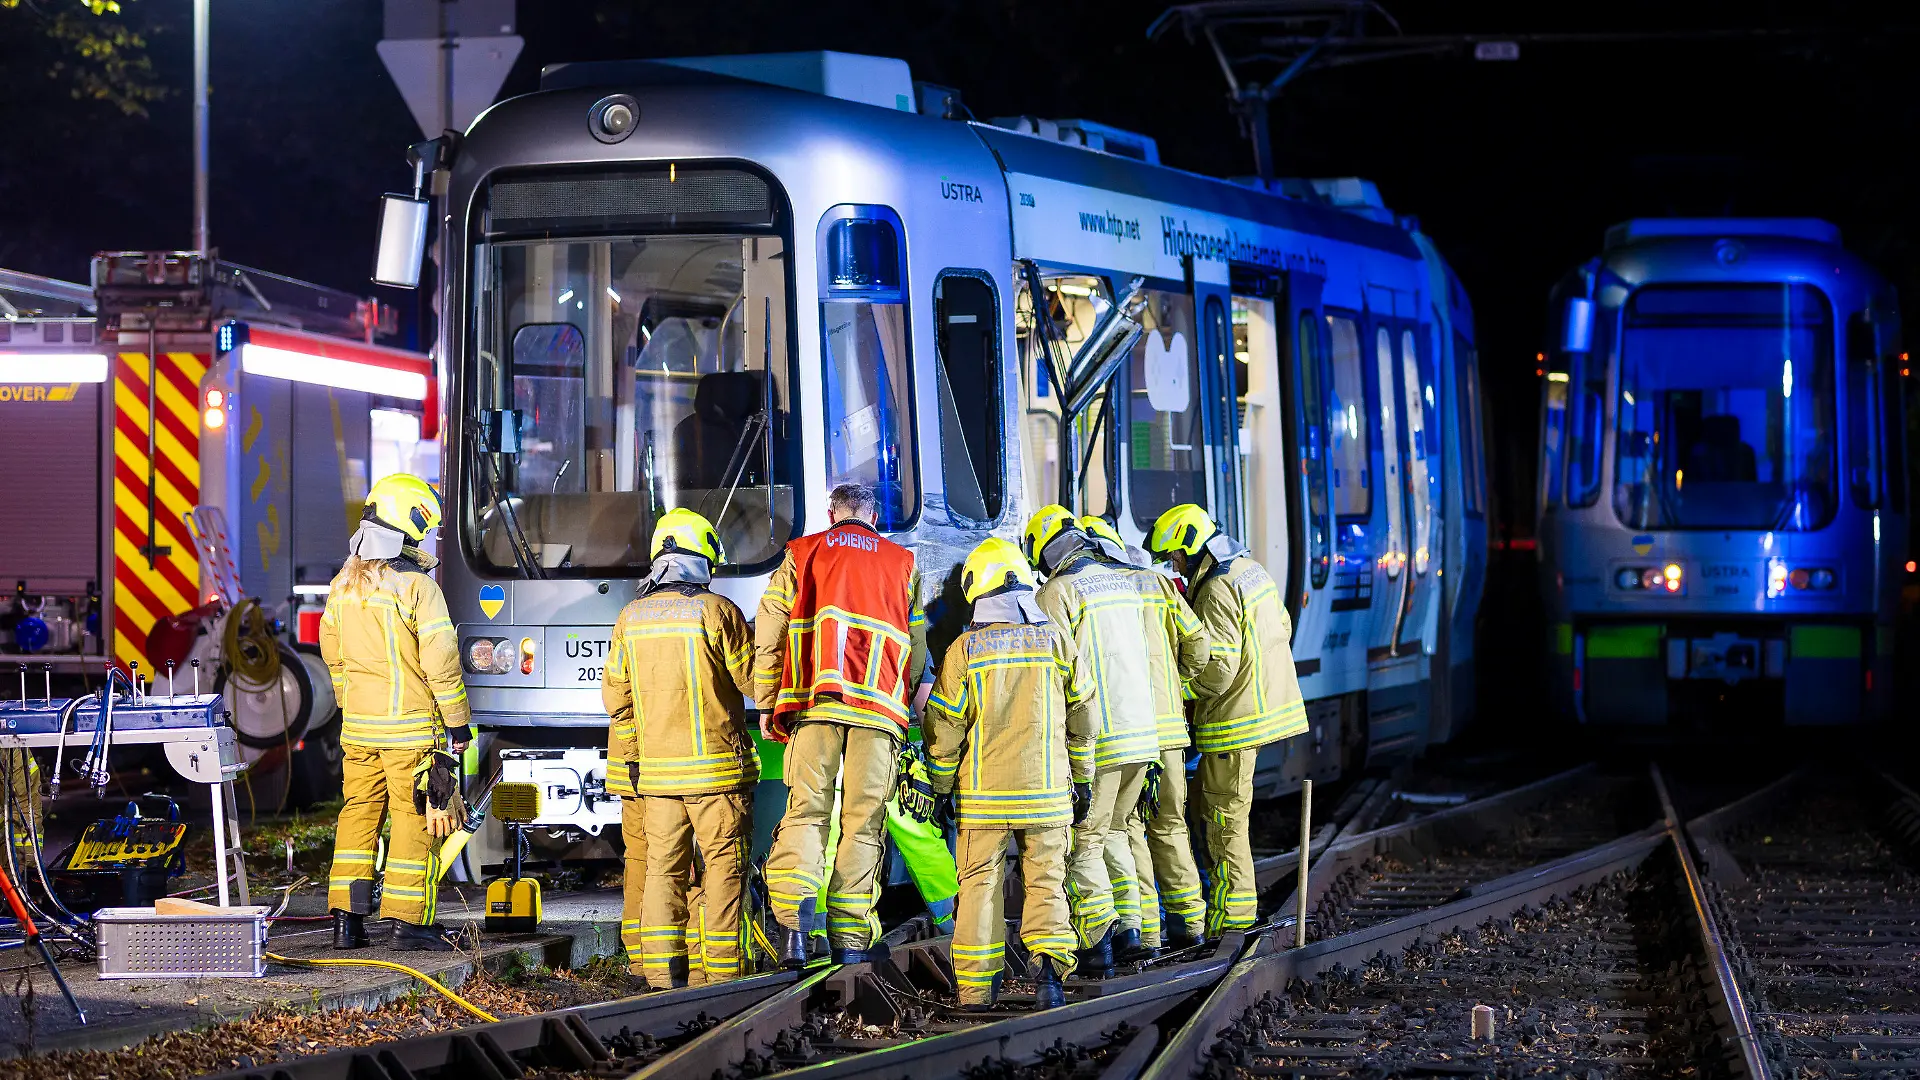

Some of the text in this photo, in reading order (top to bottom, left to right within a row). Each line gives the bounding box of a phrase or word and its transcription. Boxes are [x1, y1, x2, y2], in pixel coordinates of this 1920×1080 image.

[941, 175, 983, 203] ÜSTRA
[1079, 209, 1141, 243] www.htp.net
[0, 385, 46, 401] OVER
[826, 531, 879, 553] C-DIENST
[565, 633, 612, 658] ÜST
